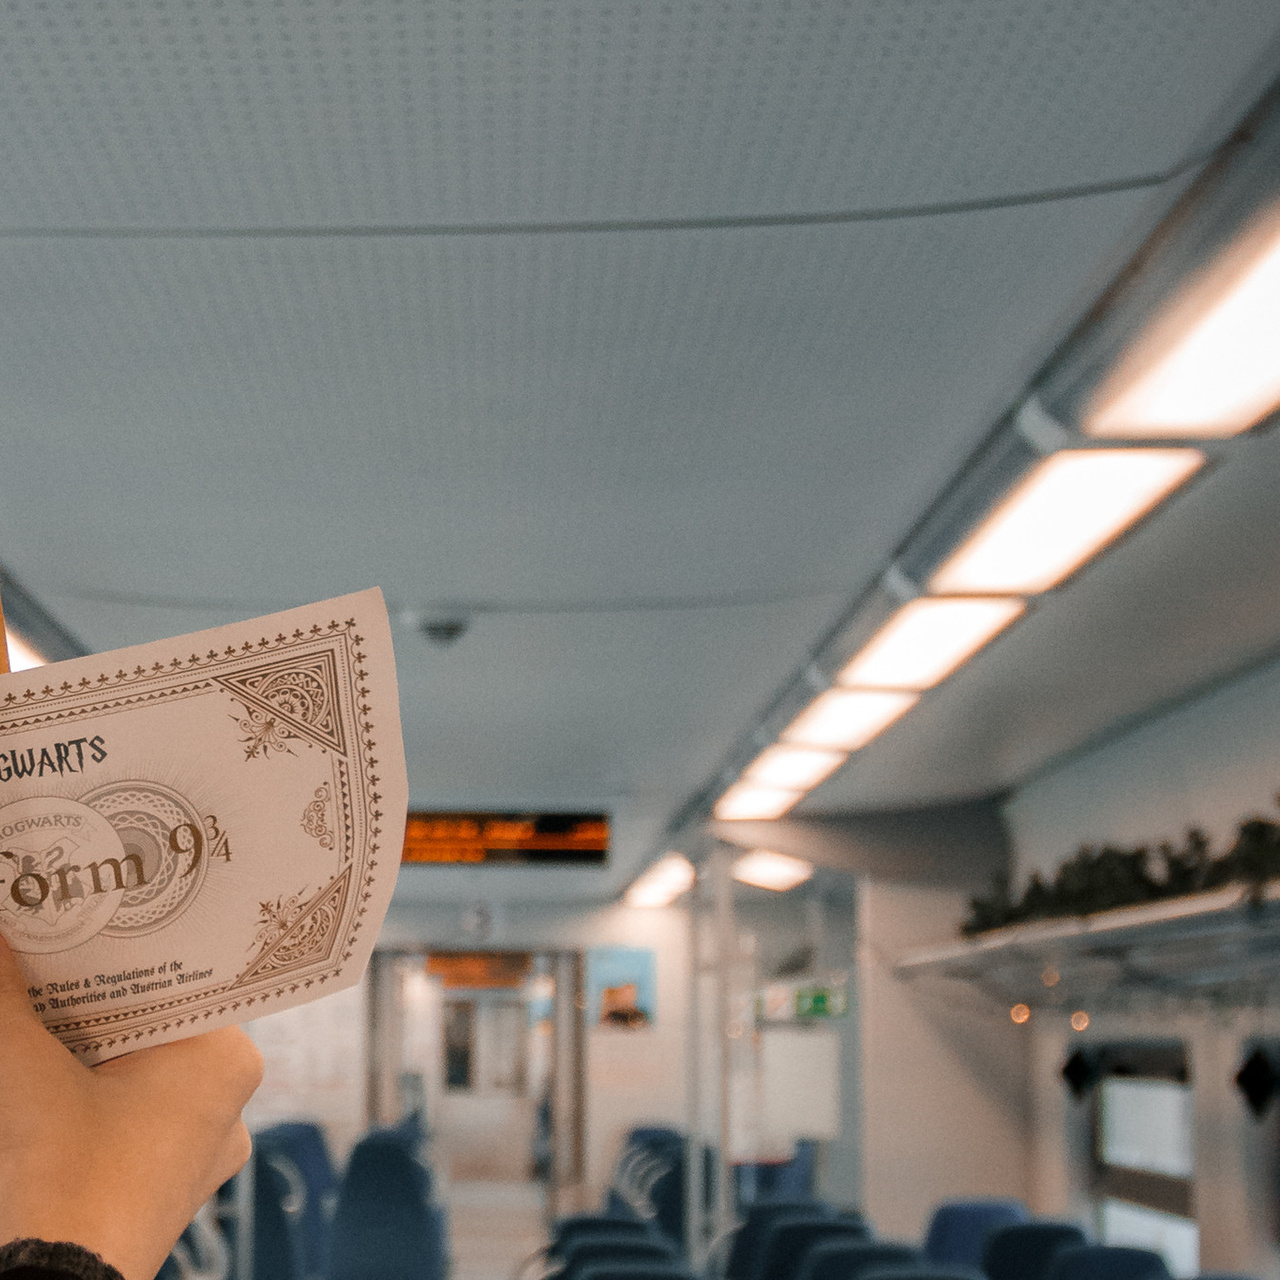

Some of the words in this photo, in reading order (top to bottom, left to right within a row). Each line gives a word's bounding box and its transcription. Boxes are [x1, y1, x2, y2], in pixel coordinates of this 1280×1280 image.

[46, 979, 81, 995] Rules
[83, 978, 92, 989] &
[94, 965, 156, 988] Regulations
[48, 990, 107, 1010] Authorities
[109, 985, 129, 1000] and
[130, 979, 173, 996] Austrian
